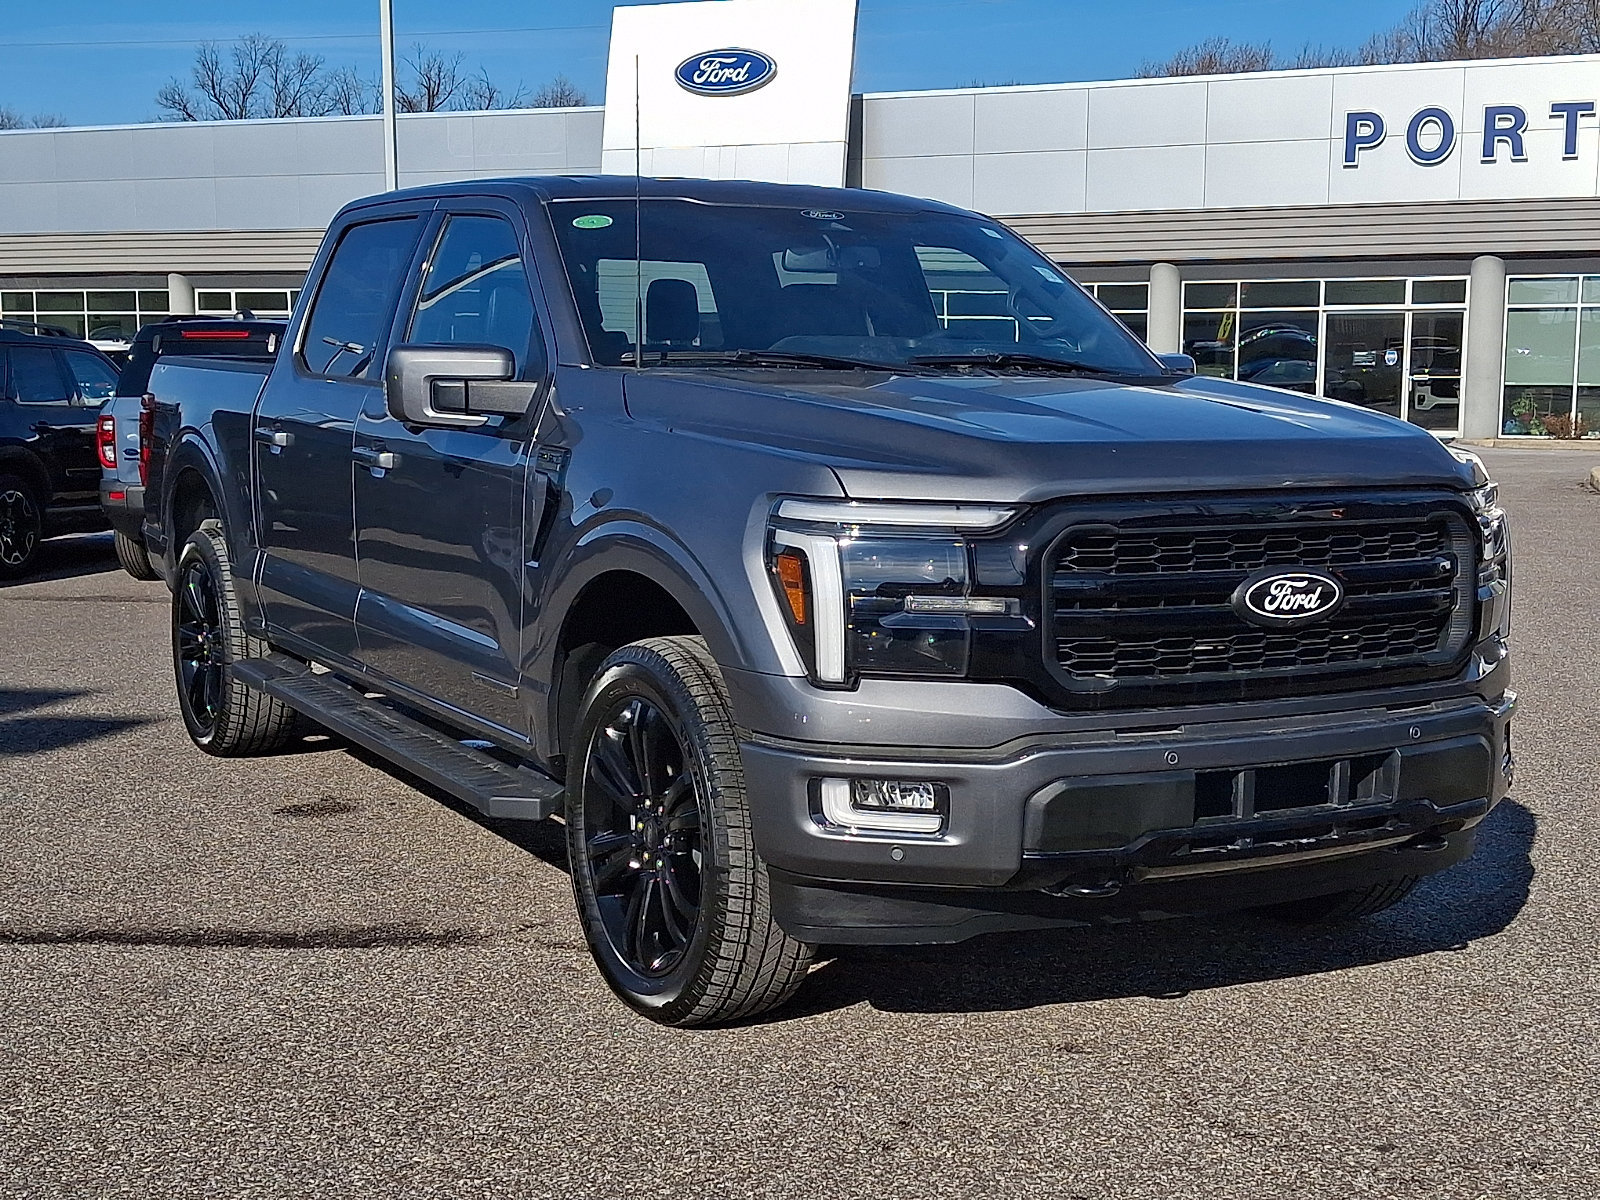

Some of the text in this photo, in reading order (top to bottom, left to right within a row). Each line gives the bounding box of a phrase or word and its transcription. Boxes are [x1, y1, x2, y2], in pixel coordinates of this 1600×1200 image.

[693, 57, 752, 84] Ford
[1343, 100, 1597, 168] PORT
[1264, 580, 1323, 611] Ford
